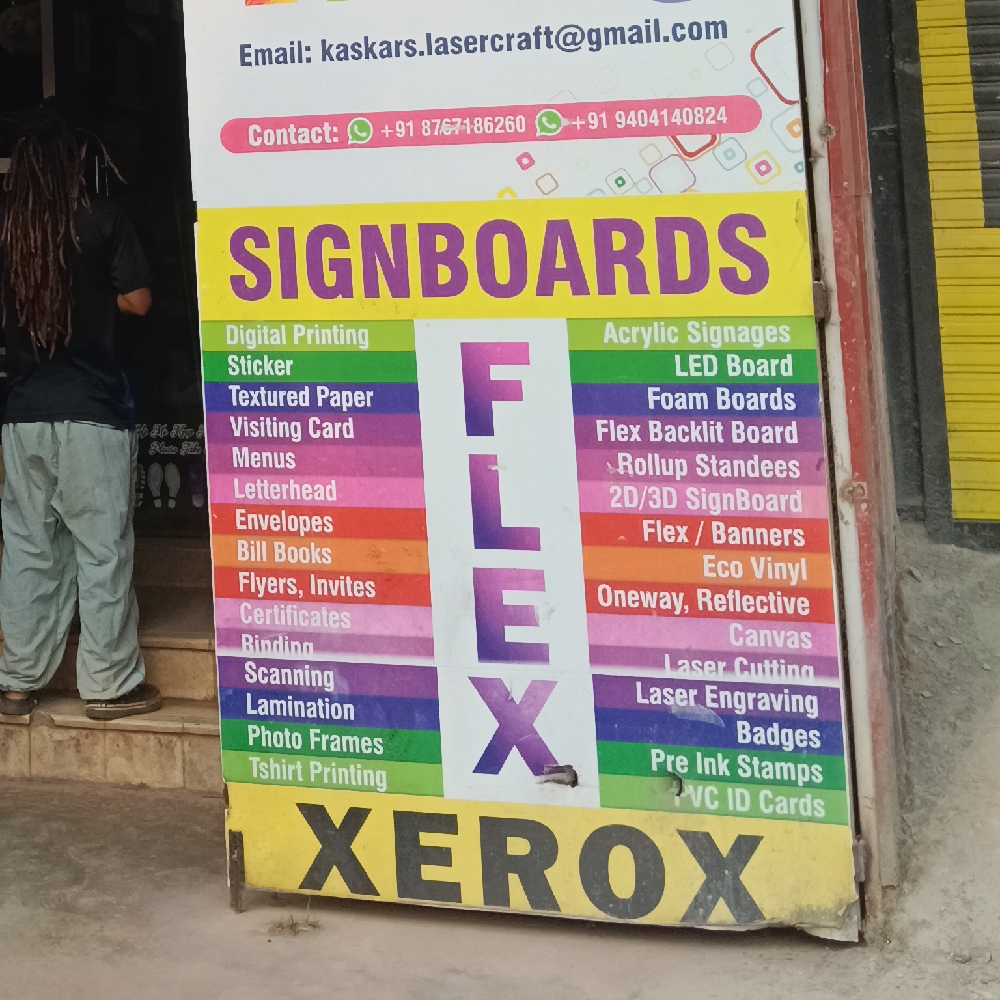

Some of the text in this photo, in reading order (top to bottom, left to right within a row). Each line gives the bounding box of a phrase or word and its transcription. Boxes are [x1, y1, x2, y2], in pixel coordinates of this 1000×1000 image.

[239, 18, 728, 67] Email: kaskars.lasercraft@gmail.com
[248, 106, 728, 146] Contact: +91 8767186260 +91 9404140824
[229, 212, 771, 302] SIGNBOARDS
[225, 324, 369, 349] Digital Printing
[603, 321, 791, 349] Acrylic Signages
[227, 354, 294, 376] Sticker
[228, 384, 374, 411] Textured Paper
[229, 415, 302, 442] Visiting
[308, 416, 355, 439] Card
[595, 419, 799, 444] Flex Backlit Board
[617, 452, 801, 481] Rollup Standees
[233, 477, 337, 502] Letterhead
[609, 485, 803, 516] 2D/3D SignBoard
[235, 508, 334, 536] Envelopes
[459, 341, 558, 777] FLEX
[702, 554, 807, 586] Eco Vinyl
[238, 571, 376, 598] Flyers, Invites
[597, 583, 811, 616] Oneway, Reflective
[240, 601, 351, 629] Certificates
[241, 633, 314, 656] Binding
[244, 661, 335, 692] Scanning
[664, 653, 815, 681] Laser Cutting
[246, 692, 355, 721] Lamination
[635, 681, 819, 719] Laser Engraving
[247, 724, 384, 755] Photo Frames
[248, 757, 387, 793] Tshirt Printing
[650, 748, 824, 787] Pre Ink Stamps
[727, 787, 751, 812] ID
[759, 790, 825, 818] Cards
[295, 802, 768, 925] XEROX
